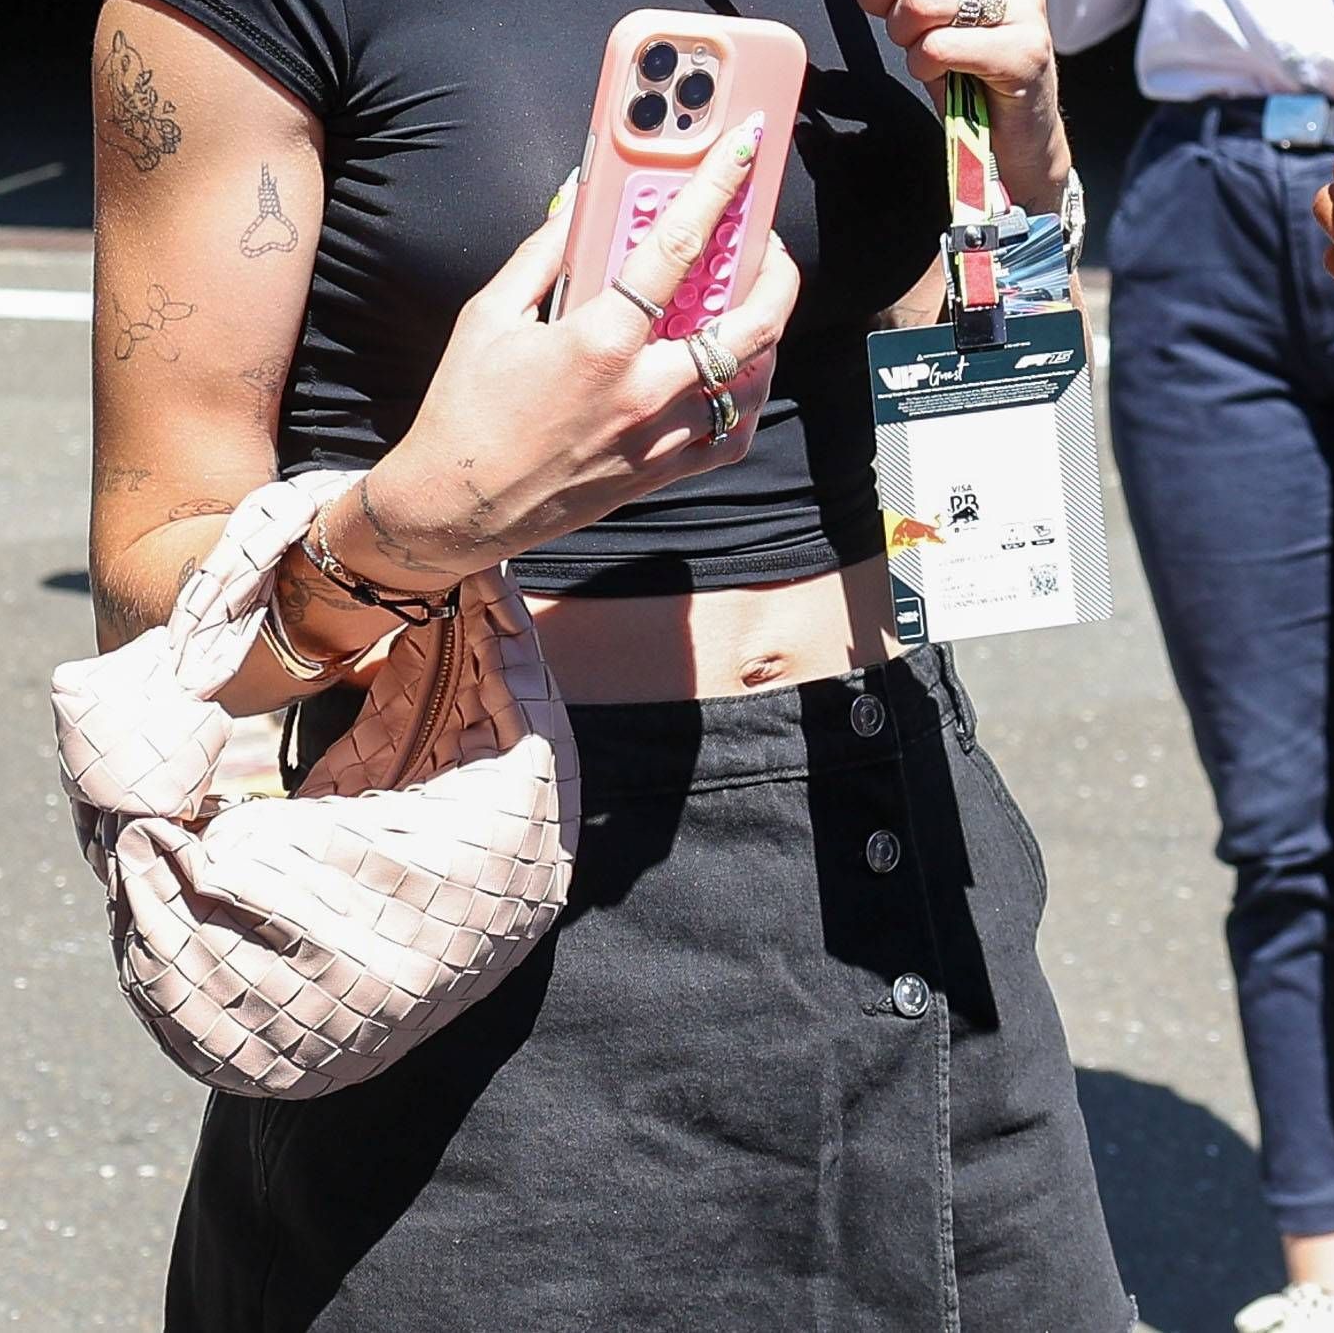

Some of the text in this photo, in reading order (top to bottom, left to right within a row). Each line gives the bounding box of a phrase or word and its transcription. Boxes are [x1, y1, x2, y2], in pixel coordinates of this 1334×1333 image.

[878, 363, 931, 391] VIP
[928, 355, 970, 387] Guest
[951, 484, 972, 493] VISA
